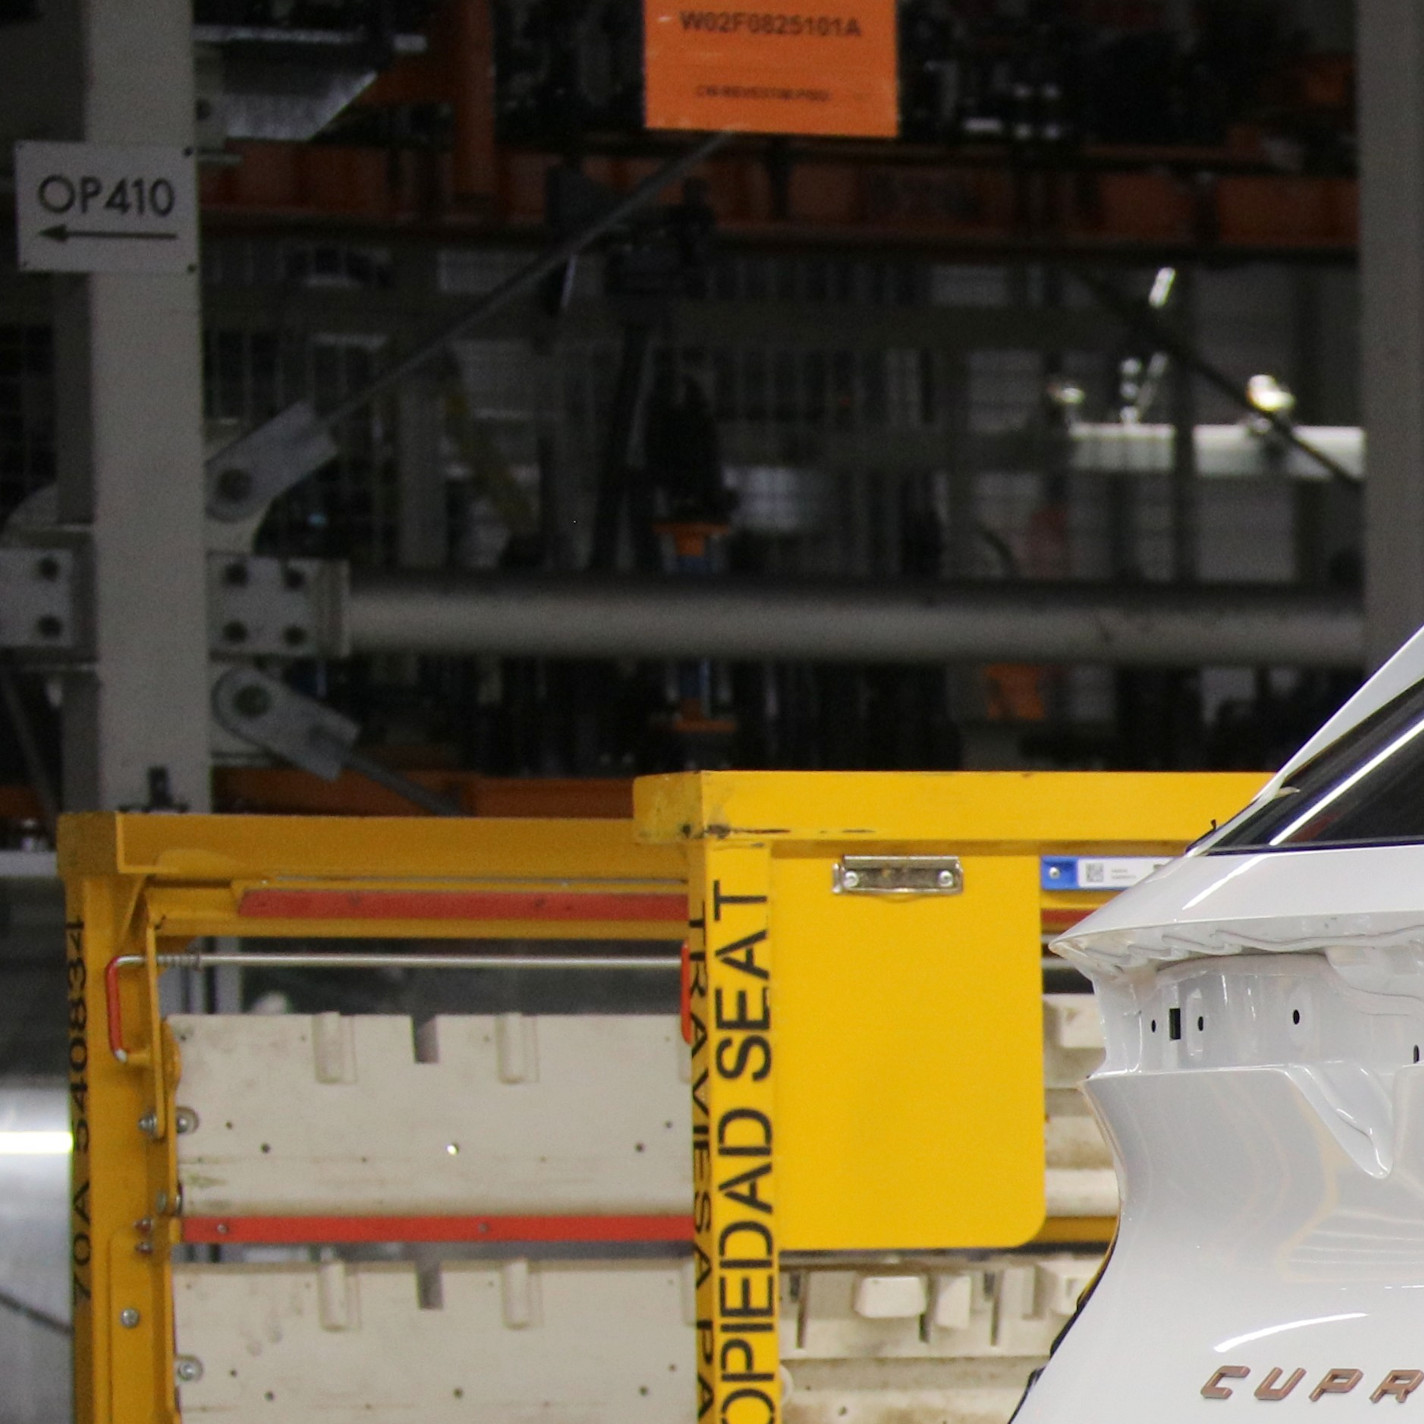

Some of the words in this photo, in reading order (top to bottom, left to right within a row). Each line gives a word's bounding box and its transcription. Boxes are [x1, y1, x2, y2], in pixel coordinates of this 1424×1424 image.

[38, 174, 176, 217] OP410
[713, 879, 773, 1082] SEAT
[688, 898, 712, 1290] TRAVIESA
